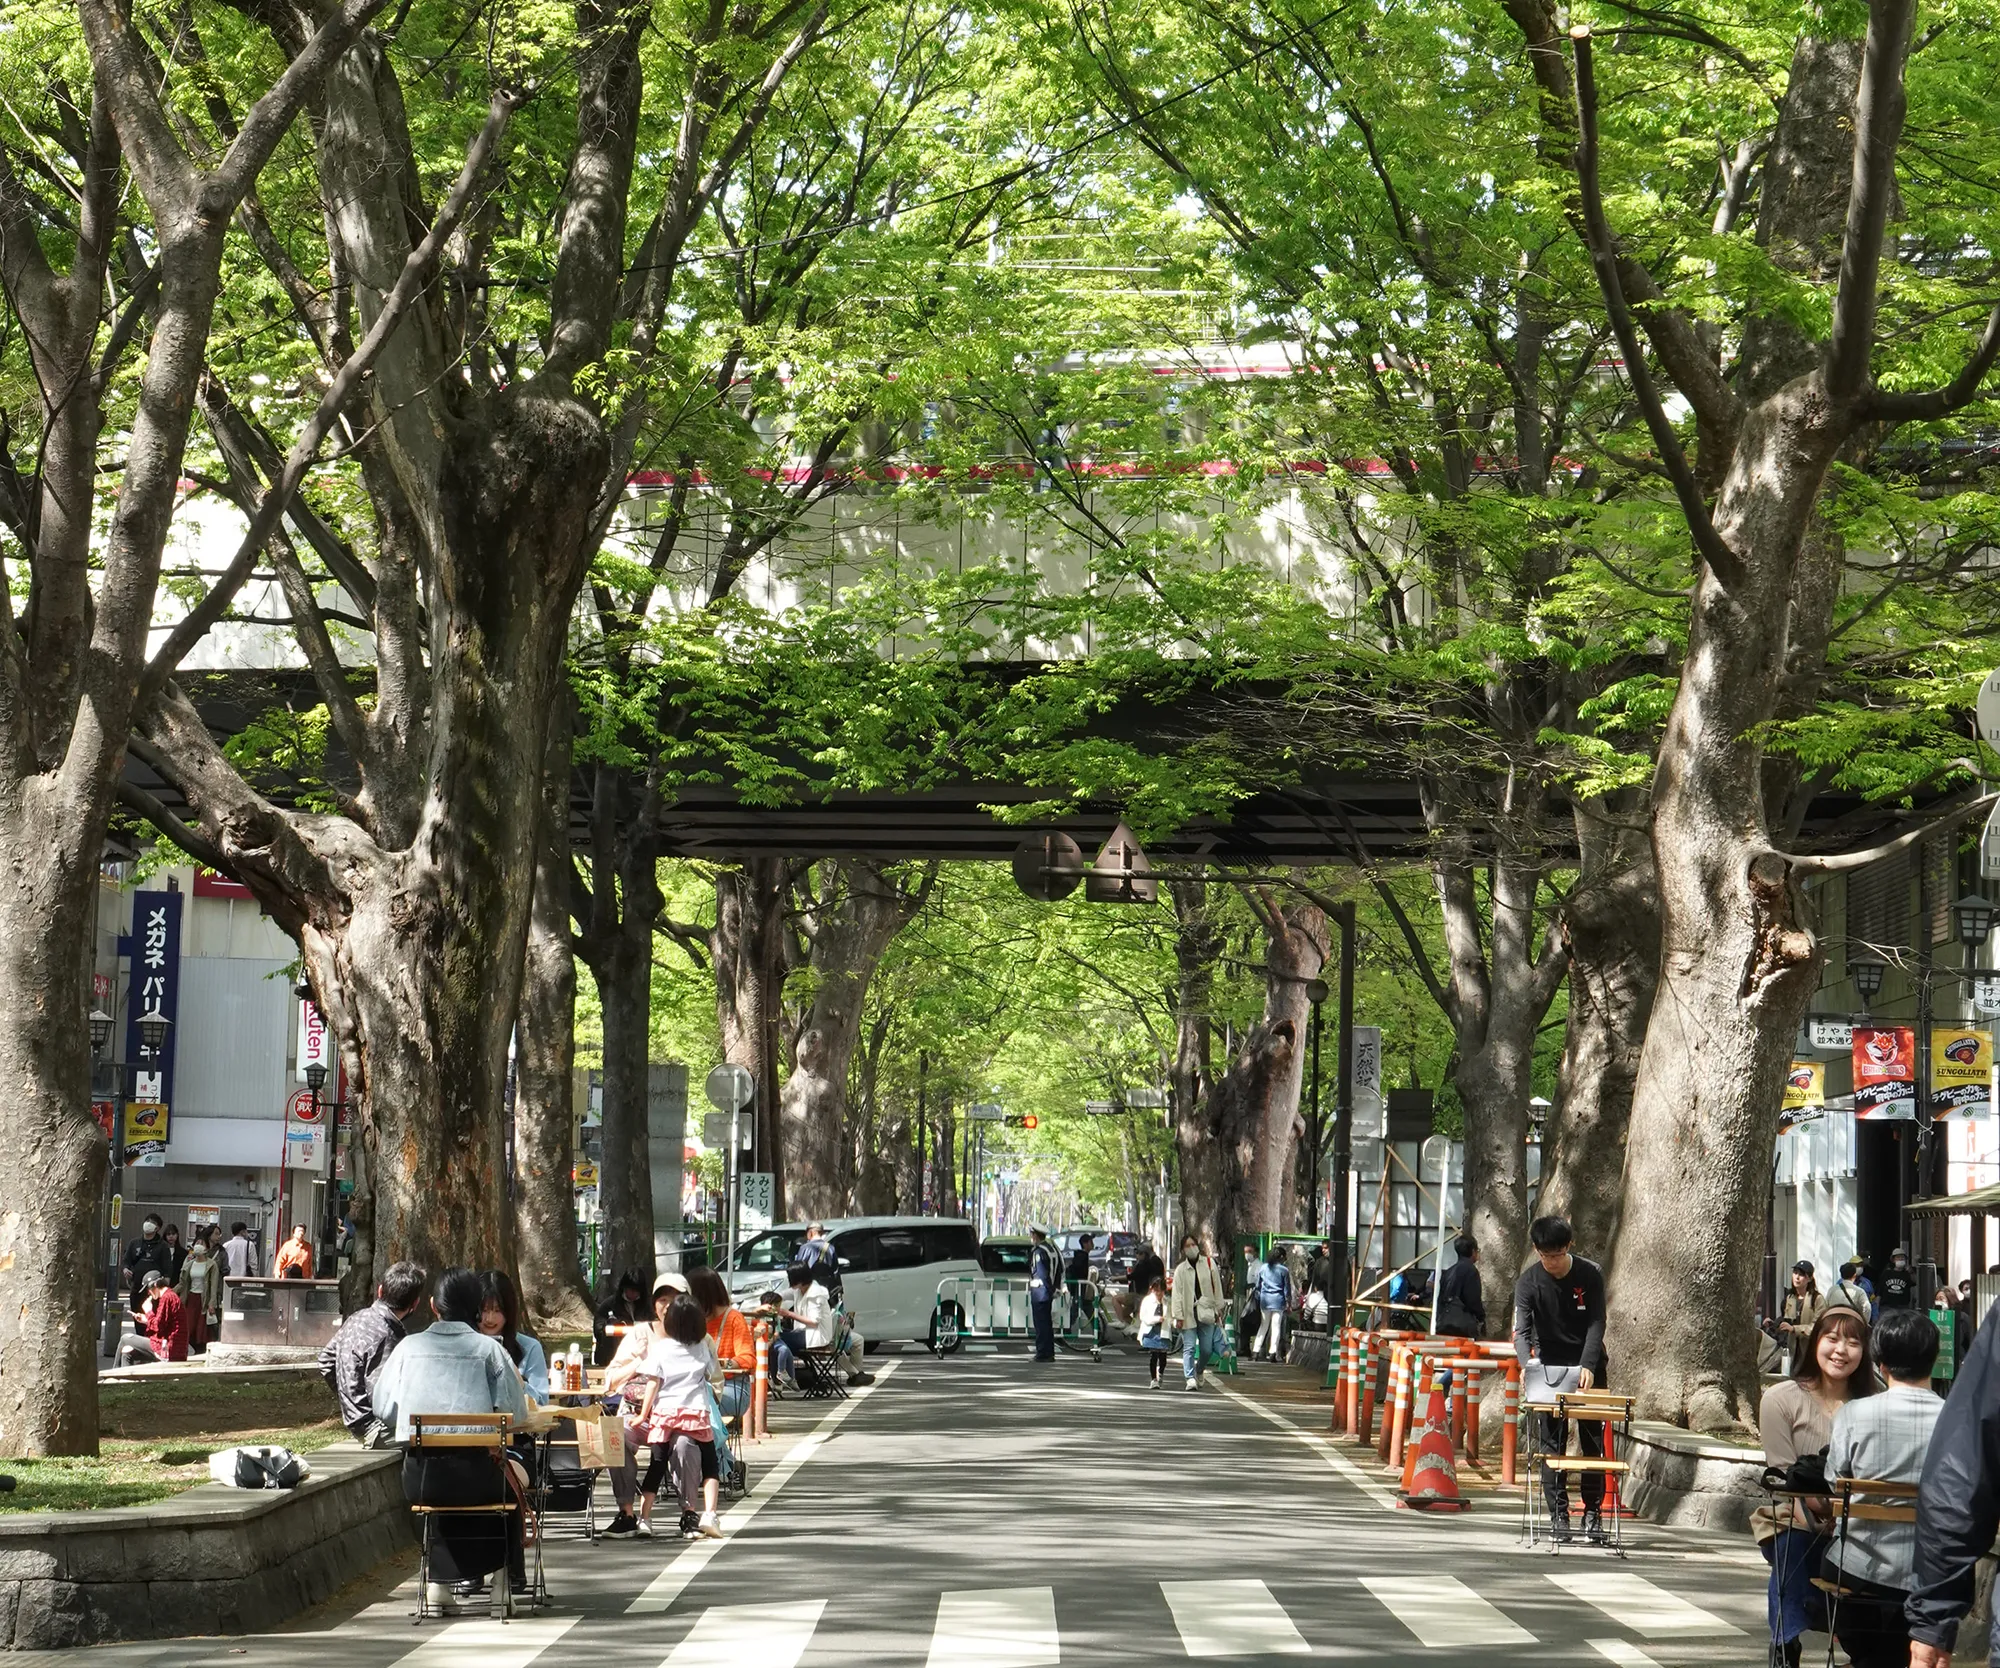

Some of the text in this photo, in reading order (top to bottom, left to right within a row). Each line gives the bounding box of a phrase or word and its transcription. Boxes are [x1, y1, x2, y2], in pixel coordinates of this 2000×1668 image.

[140, 907, 166, 1062] メガネ パリキ
[1816, 1036, 1853, 1046] 並木通り
[1936, 1068, 1988, 1076] SUNGOLIATH
[296, 1101, 320, 1113] 消火
